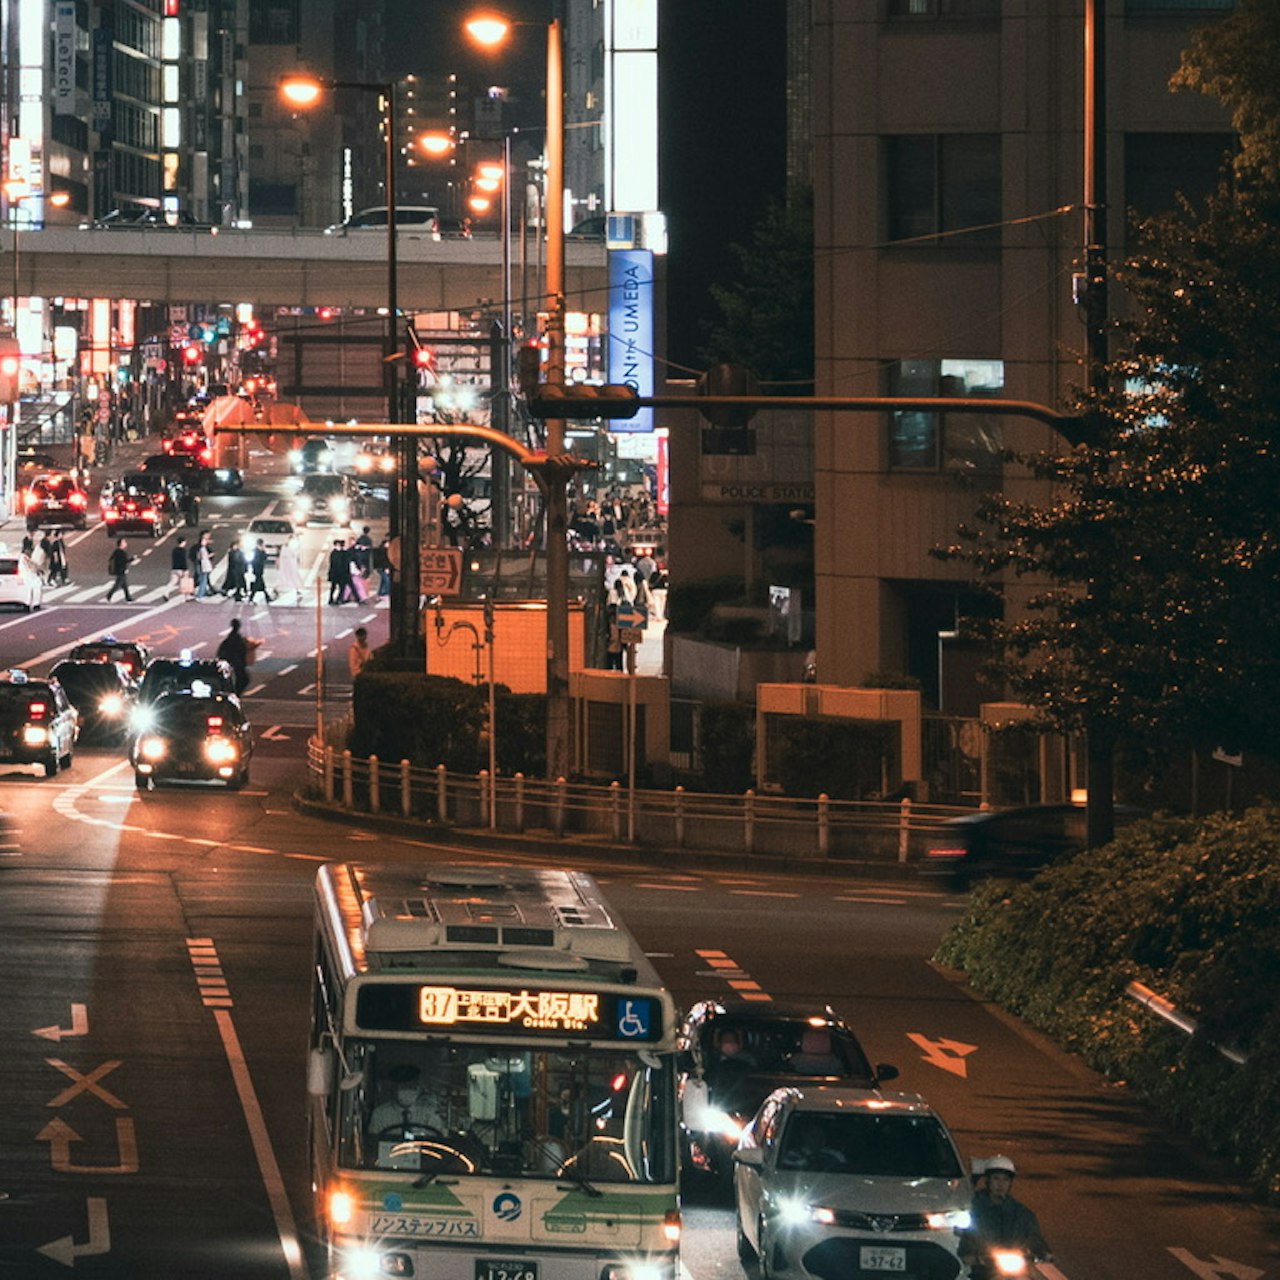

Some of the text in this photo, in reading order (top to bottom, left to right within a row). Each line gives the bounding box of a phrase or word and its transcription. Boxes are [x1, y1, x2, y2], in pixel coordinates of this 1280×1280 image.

[59, 32, 72, 98] LeTech
[623, 265, 639, 332] UMEDA
[721, 486, 767, 498] POLICE
[424, 992, 452, 1018] 37
[510, 990, 599, 1023] 大阪駅
[522, 1017, 558, 1029] Osaka
[372, 1217, 477, 1236] ノンステップバス
